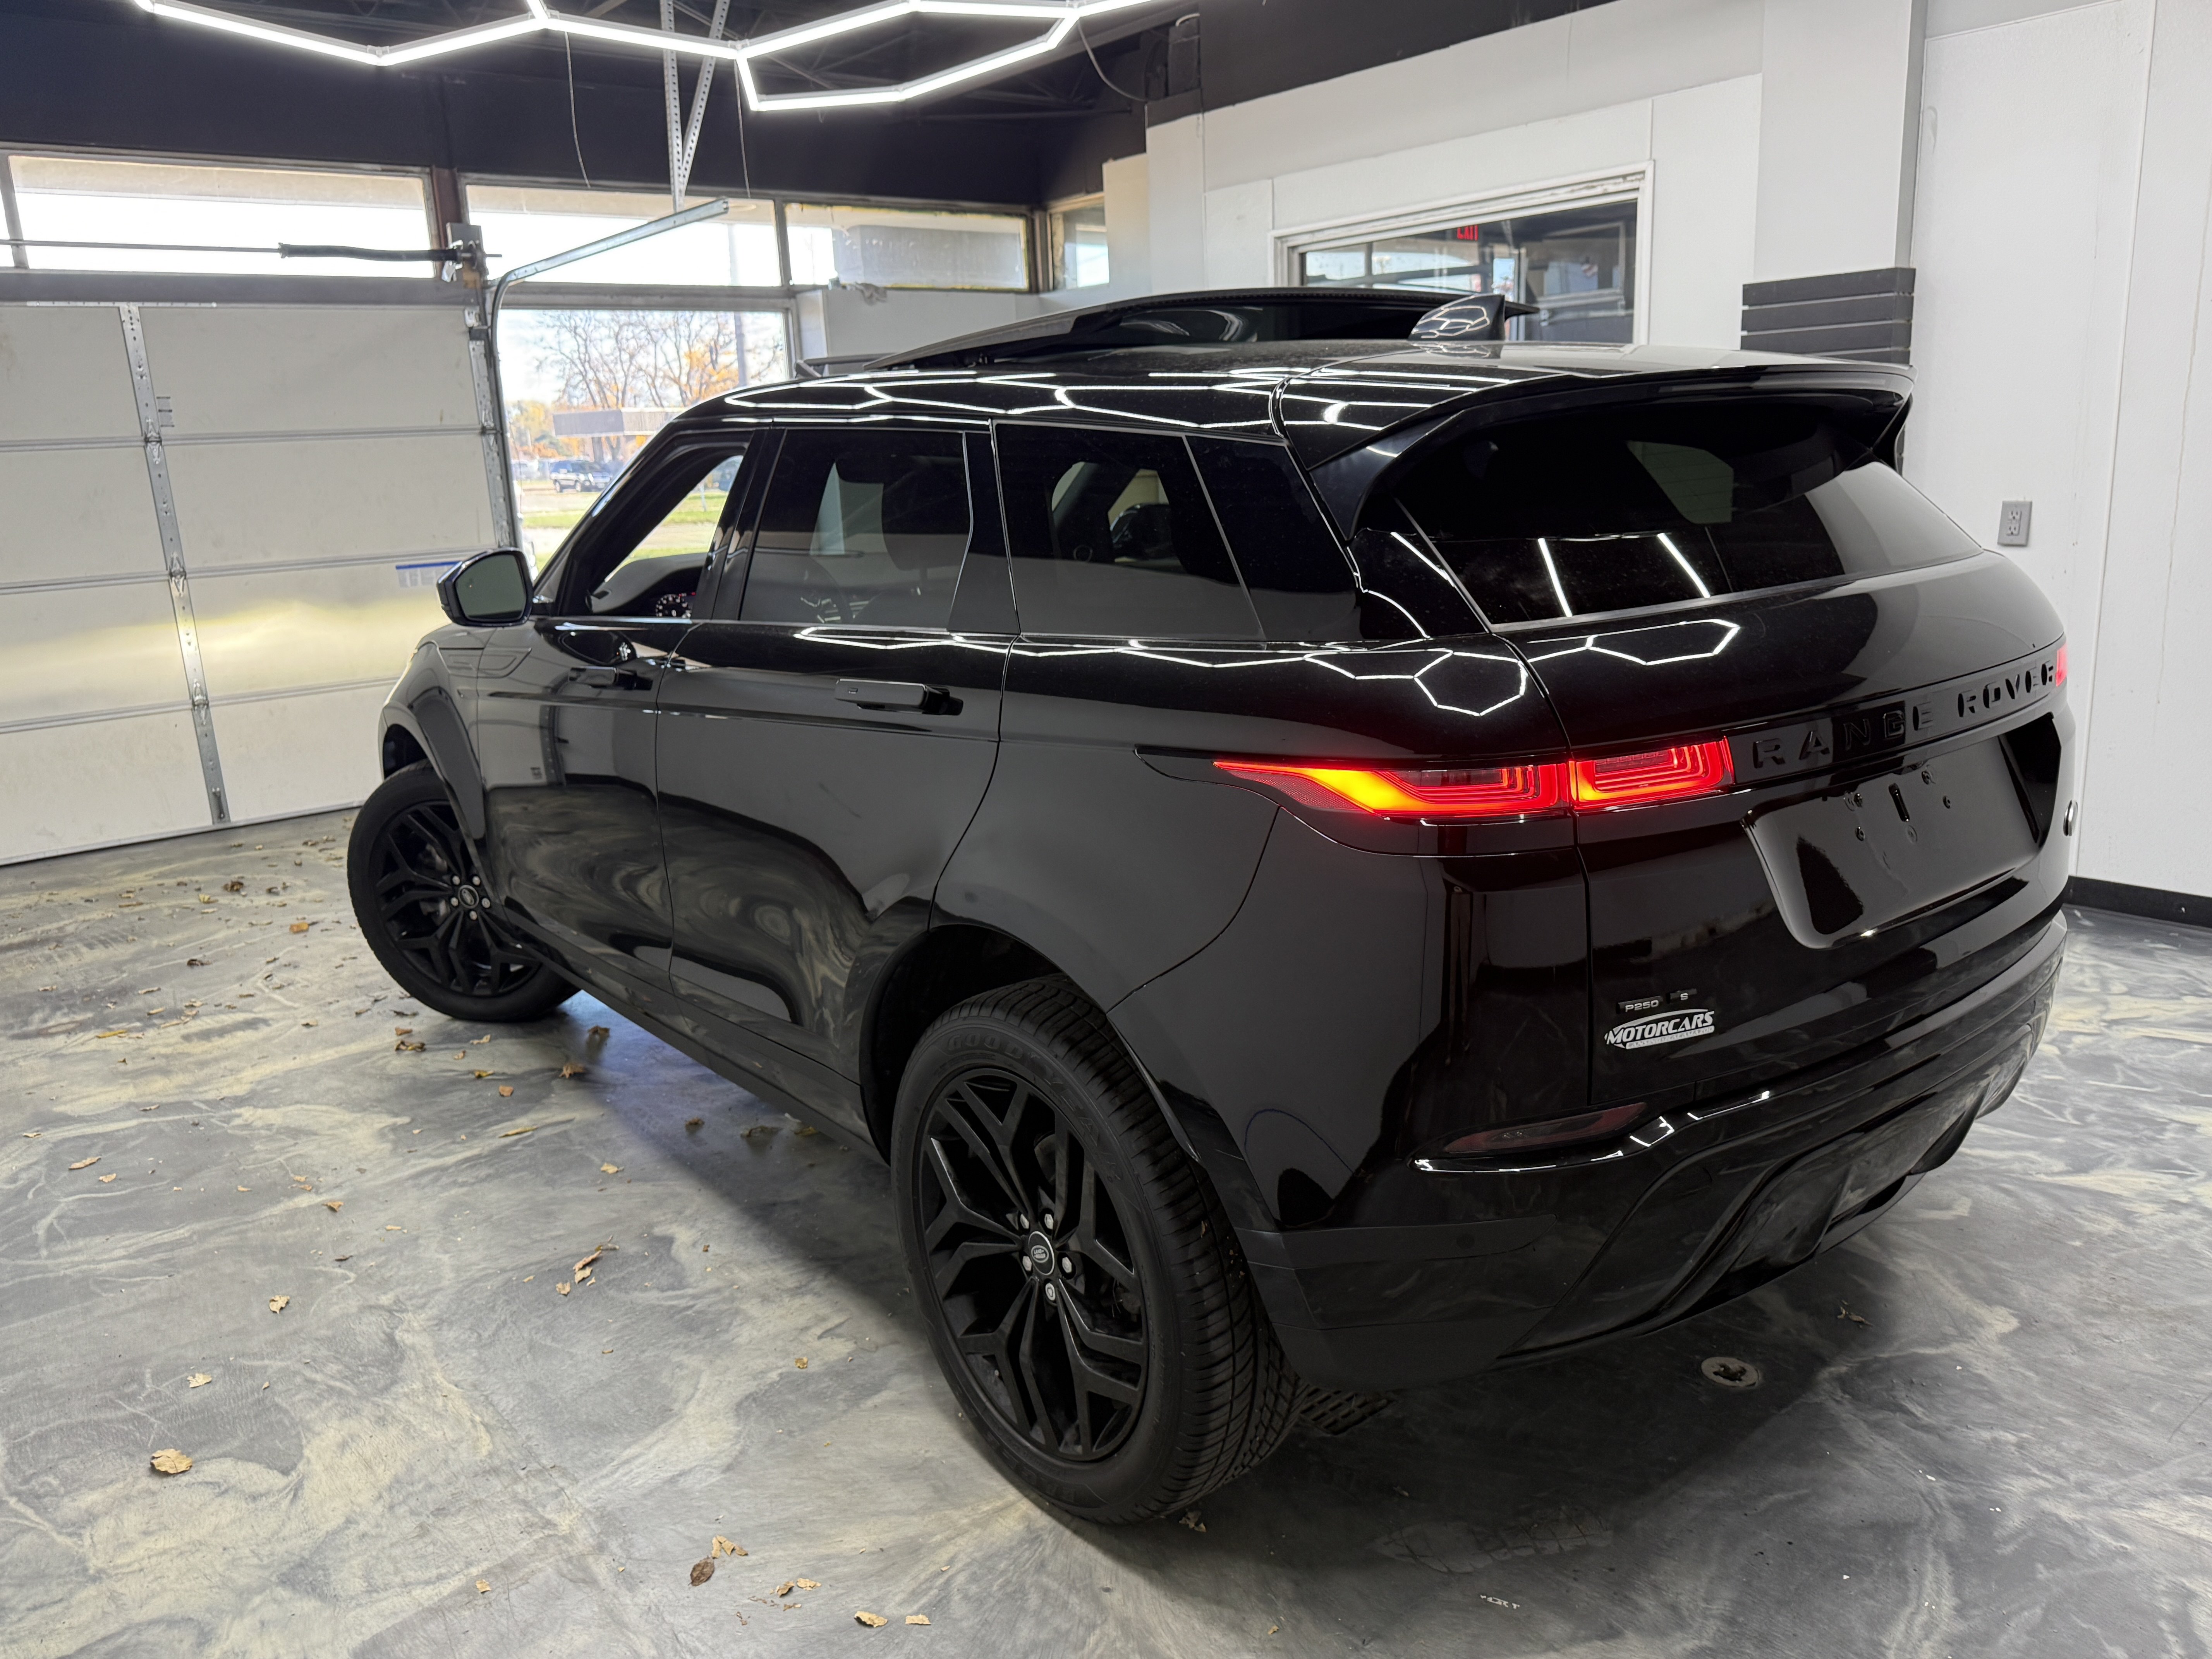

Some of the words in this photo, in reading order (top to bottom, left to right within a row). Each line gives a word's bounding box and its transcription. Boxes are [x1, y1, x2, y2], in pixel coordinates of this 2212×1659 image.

[1753, 701, 1934, 769] RANGE
[1957, 659, 2055, 718] ROVER
[1625, 1000, 1659, 1012] P250
[1606, 1010, 1715, 1045] MOTORCARS
